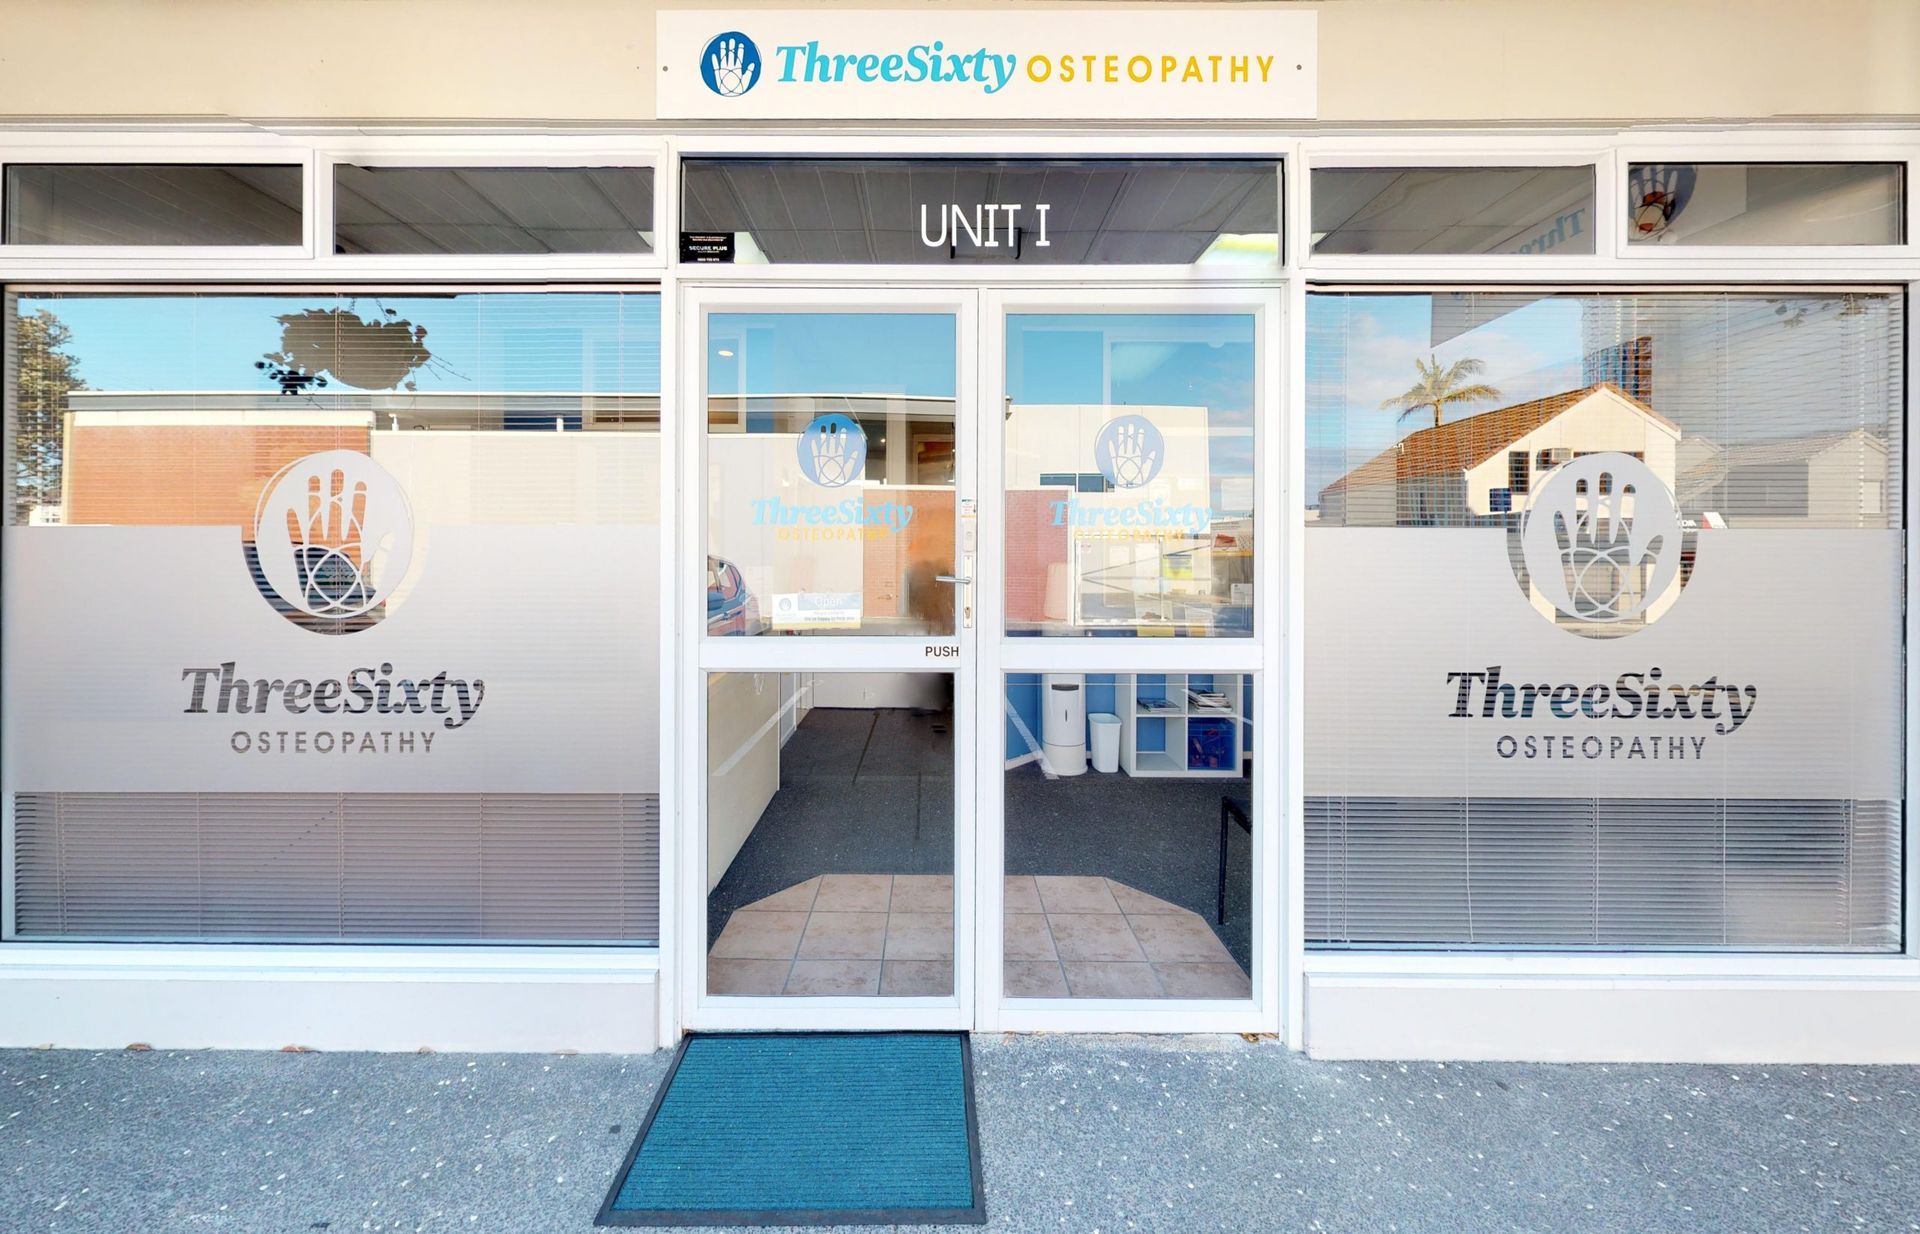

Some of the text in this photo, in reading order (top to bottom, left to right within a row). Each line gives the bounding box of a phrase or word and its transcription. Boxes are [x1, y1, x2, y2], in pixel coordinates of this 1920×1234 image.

[775, 40, 1275, 94] ThreeSixty OSTEOPATHY
[920, 203, 1021, 247] UNIT
[751, 496, 914, 534] ThreeSixty
[1049, 496, 1214, 534] ThreeSixty
[776, 527, 888, 542] OSTEOPATHY
[1074, 528, 1185, 543] OSTEOPATHY
[924, 645, 960, 658] PUSH
[181, 661, 486, 729] ThreeSixty
[1446, 665, 1757, 735] ThreeSixty
[230, 730, 436, 754] OSTEOPATHY
[1496, 735, 1706, 760] OSTEOPATHY
